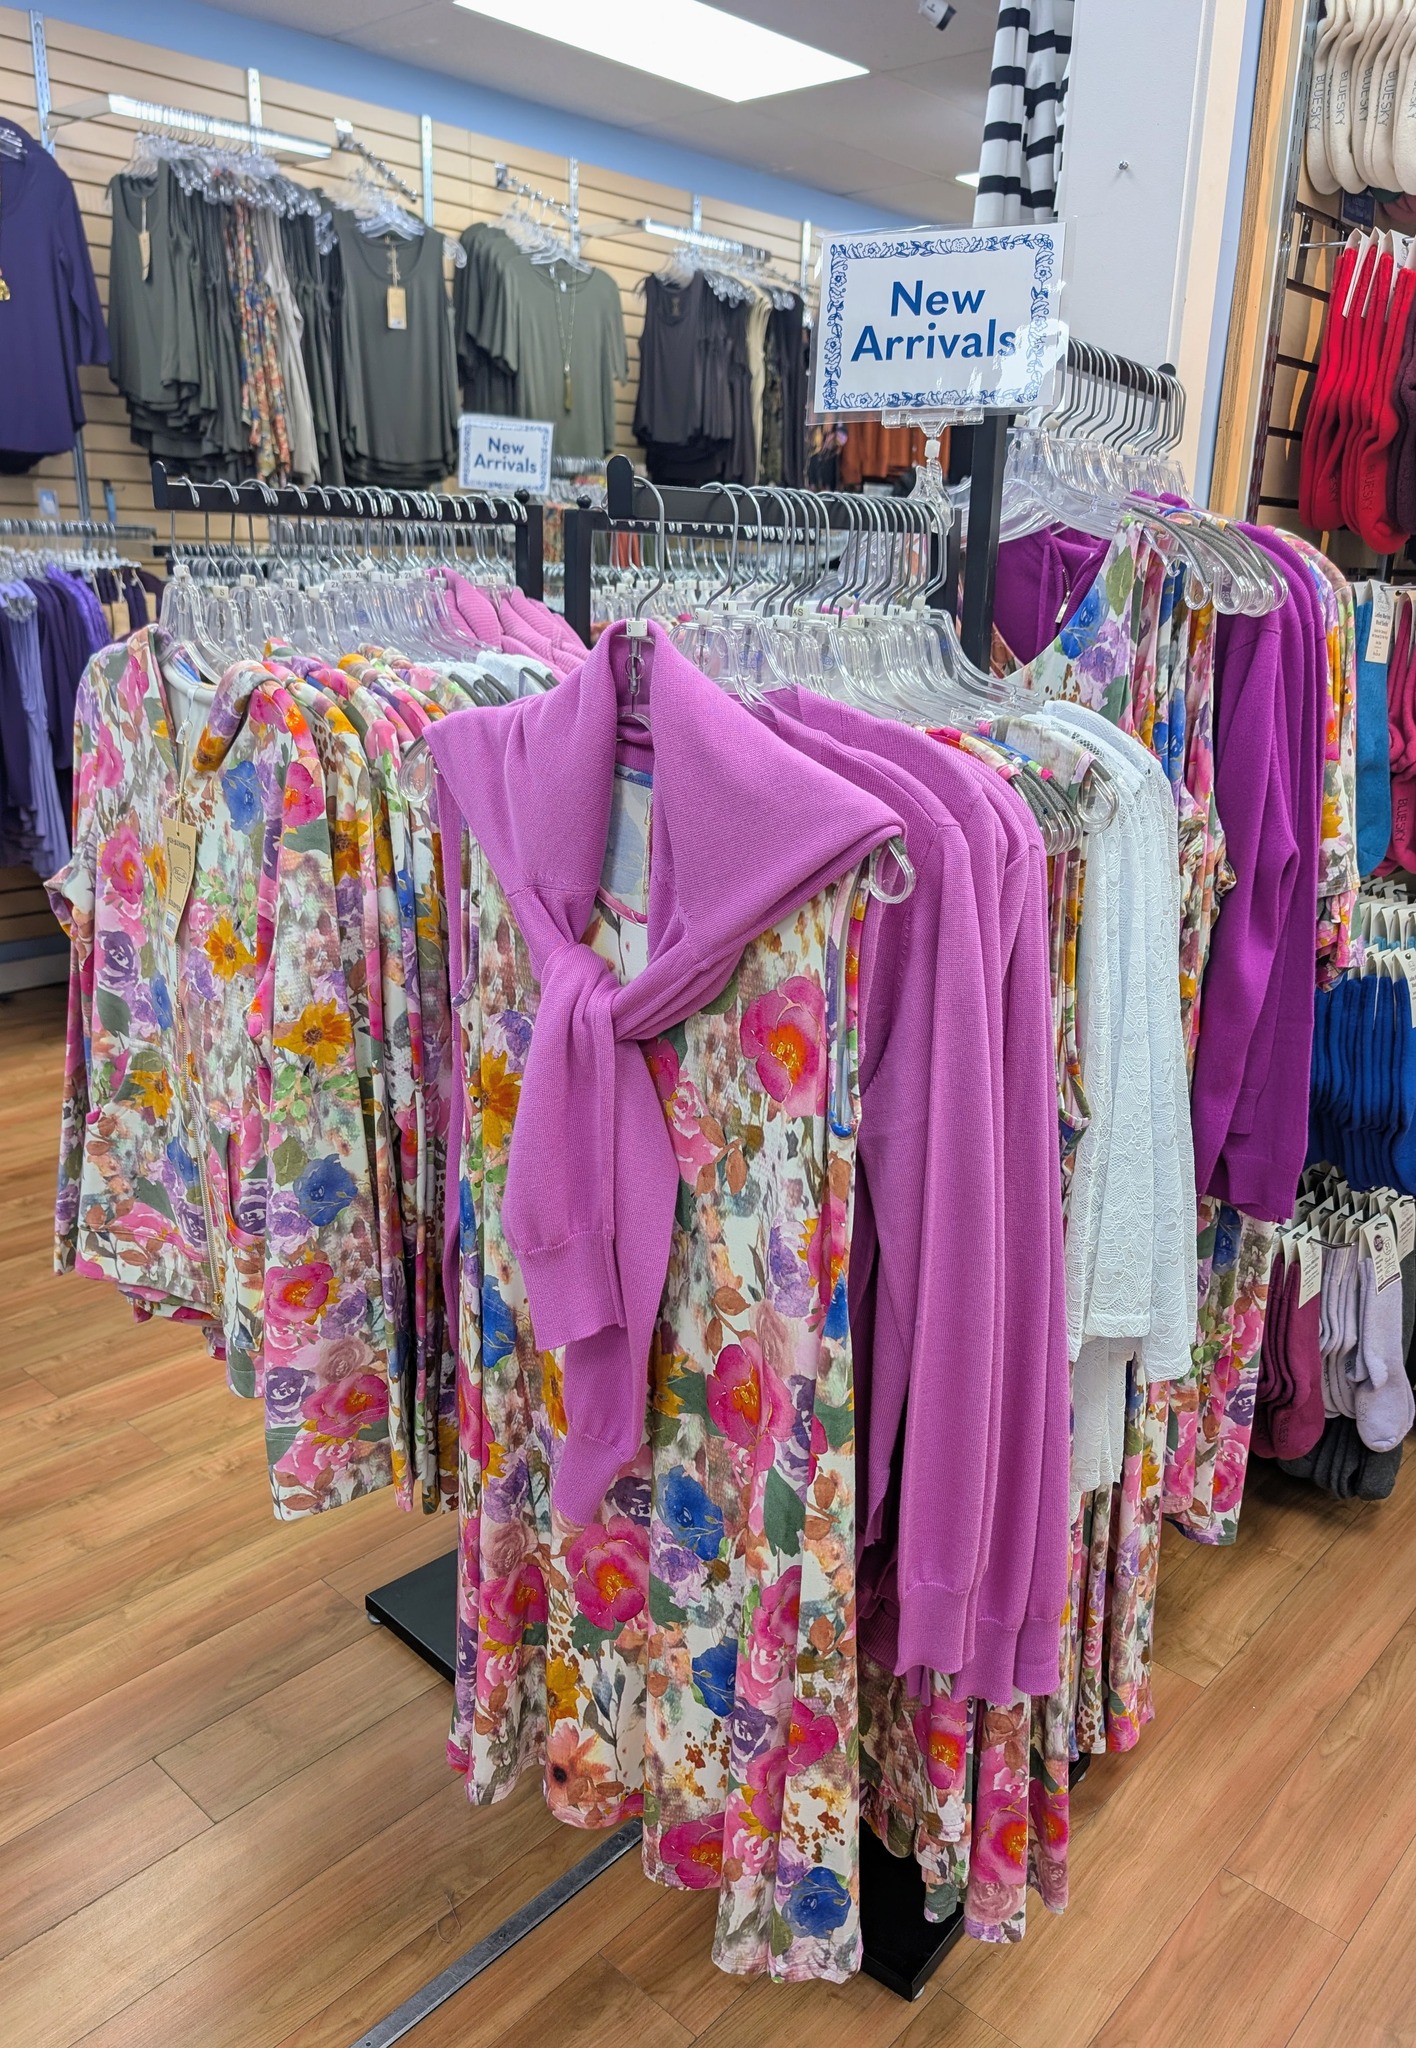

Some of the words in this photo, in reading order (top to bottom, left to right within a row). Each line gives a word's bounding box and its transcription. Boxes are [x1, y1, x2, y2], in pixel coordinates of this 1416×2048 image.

[1309, 73, 1326, 131] BLUESKY
[1335, 70, 1349, 126] BLUESKY
[1378, 70, 1399, 127] BLUESKY
[891, 280, 986, 317] New
[850, 319, 1016, 362] Arrivals
[474, 452, 537, 474] Arrivals
[488, 437, 525, 454] New
[1395, 798, 1408, 842] BLUESKY
